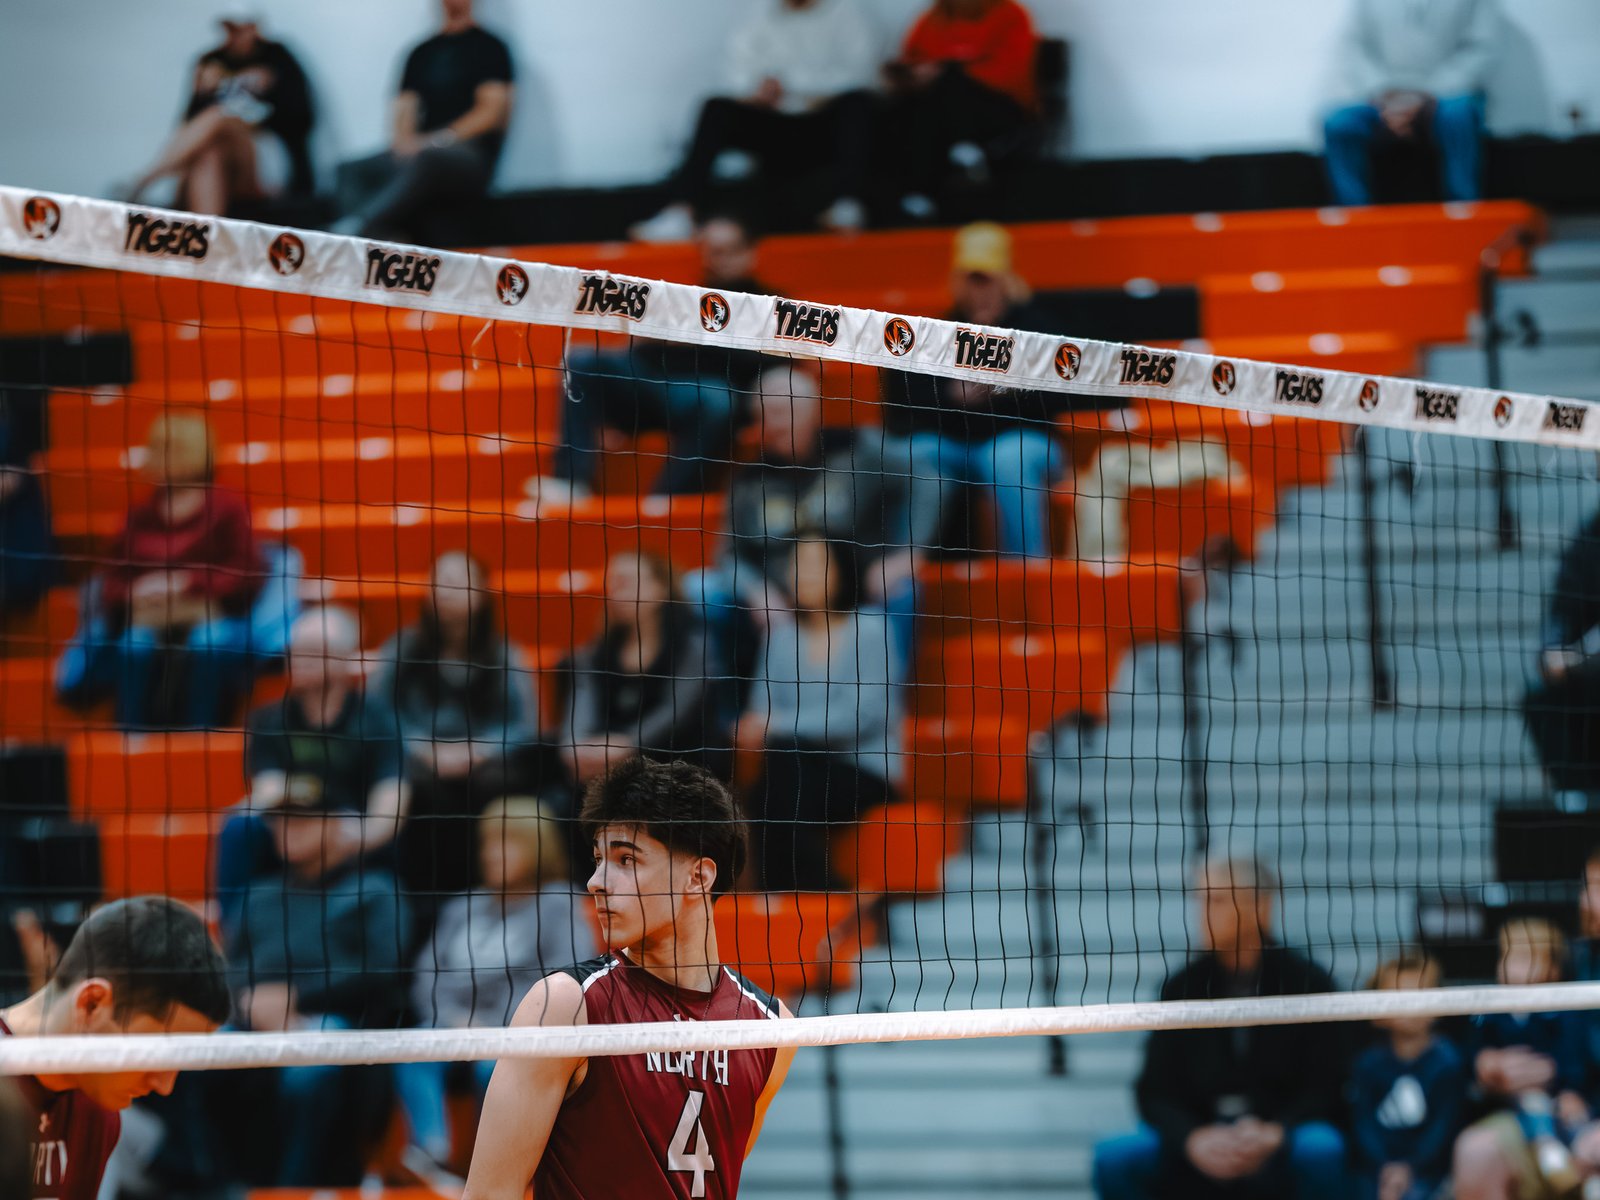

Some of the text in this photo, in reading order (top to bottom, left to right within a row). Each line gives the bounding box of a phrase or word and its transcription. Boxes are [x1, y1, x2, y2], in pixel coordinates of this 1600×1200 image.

[125, 209, 209, 262] TIGERS
[366, 245, 441, 295] TIGERS
[574, 272, 651, 322] TIGERS
[774, 298, 840, 346] TIGERS
[955, 327, 1014, 373] TIGERS
[1119, 347, 1176, 387] TIGERS
[667, 1090, 715, 1198] 4
